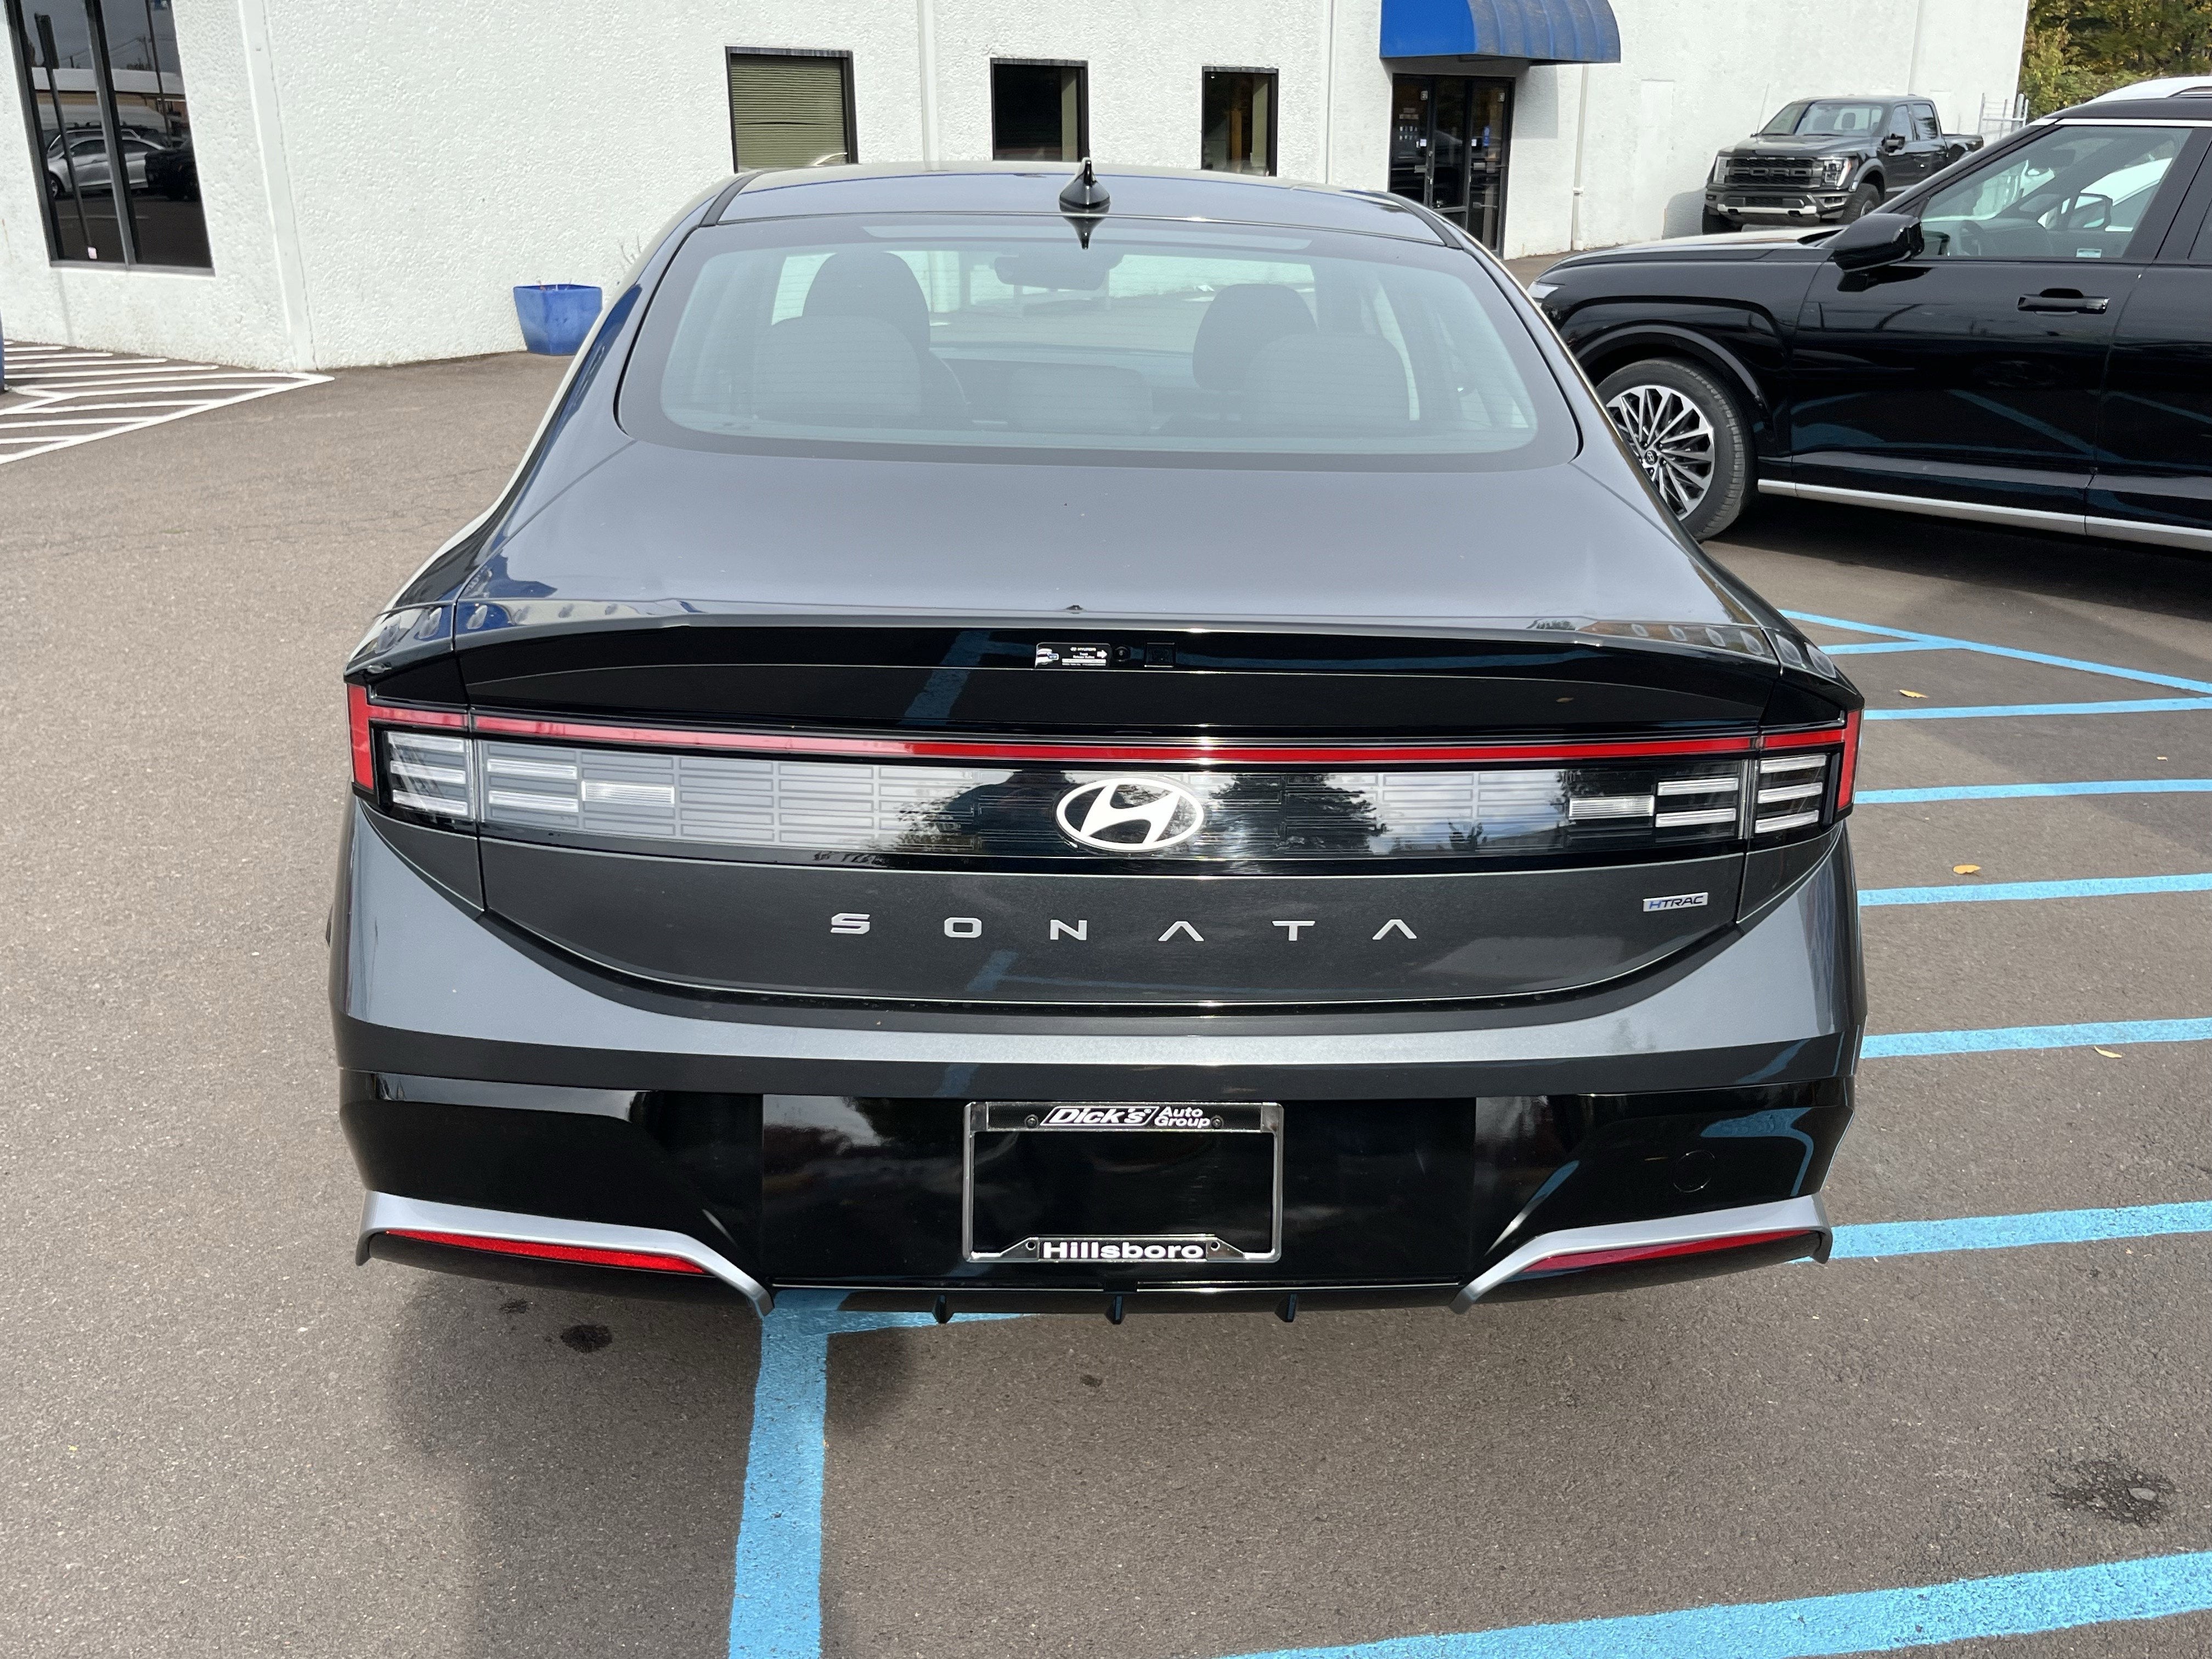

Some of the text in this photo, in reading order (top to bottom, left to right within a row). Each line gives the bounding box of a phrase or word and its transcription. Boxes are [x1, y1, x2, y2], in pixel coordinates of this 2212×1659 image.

[1729, 166, 1813, 177] FORD
[1649, 895, 1703, 910] HTRAC
[830, 912, 1418, 942] SONATA
[1159, 1106, 1203, 1118] Auto
[1154, 1115, 1211, 1128] Group
[1042, 1241, 1205, 1260] Hillsboro
